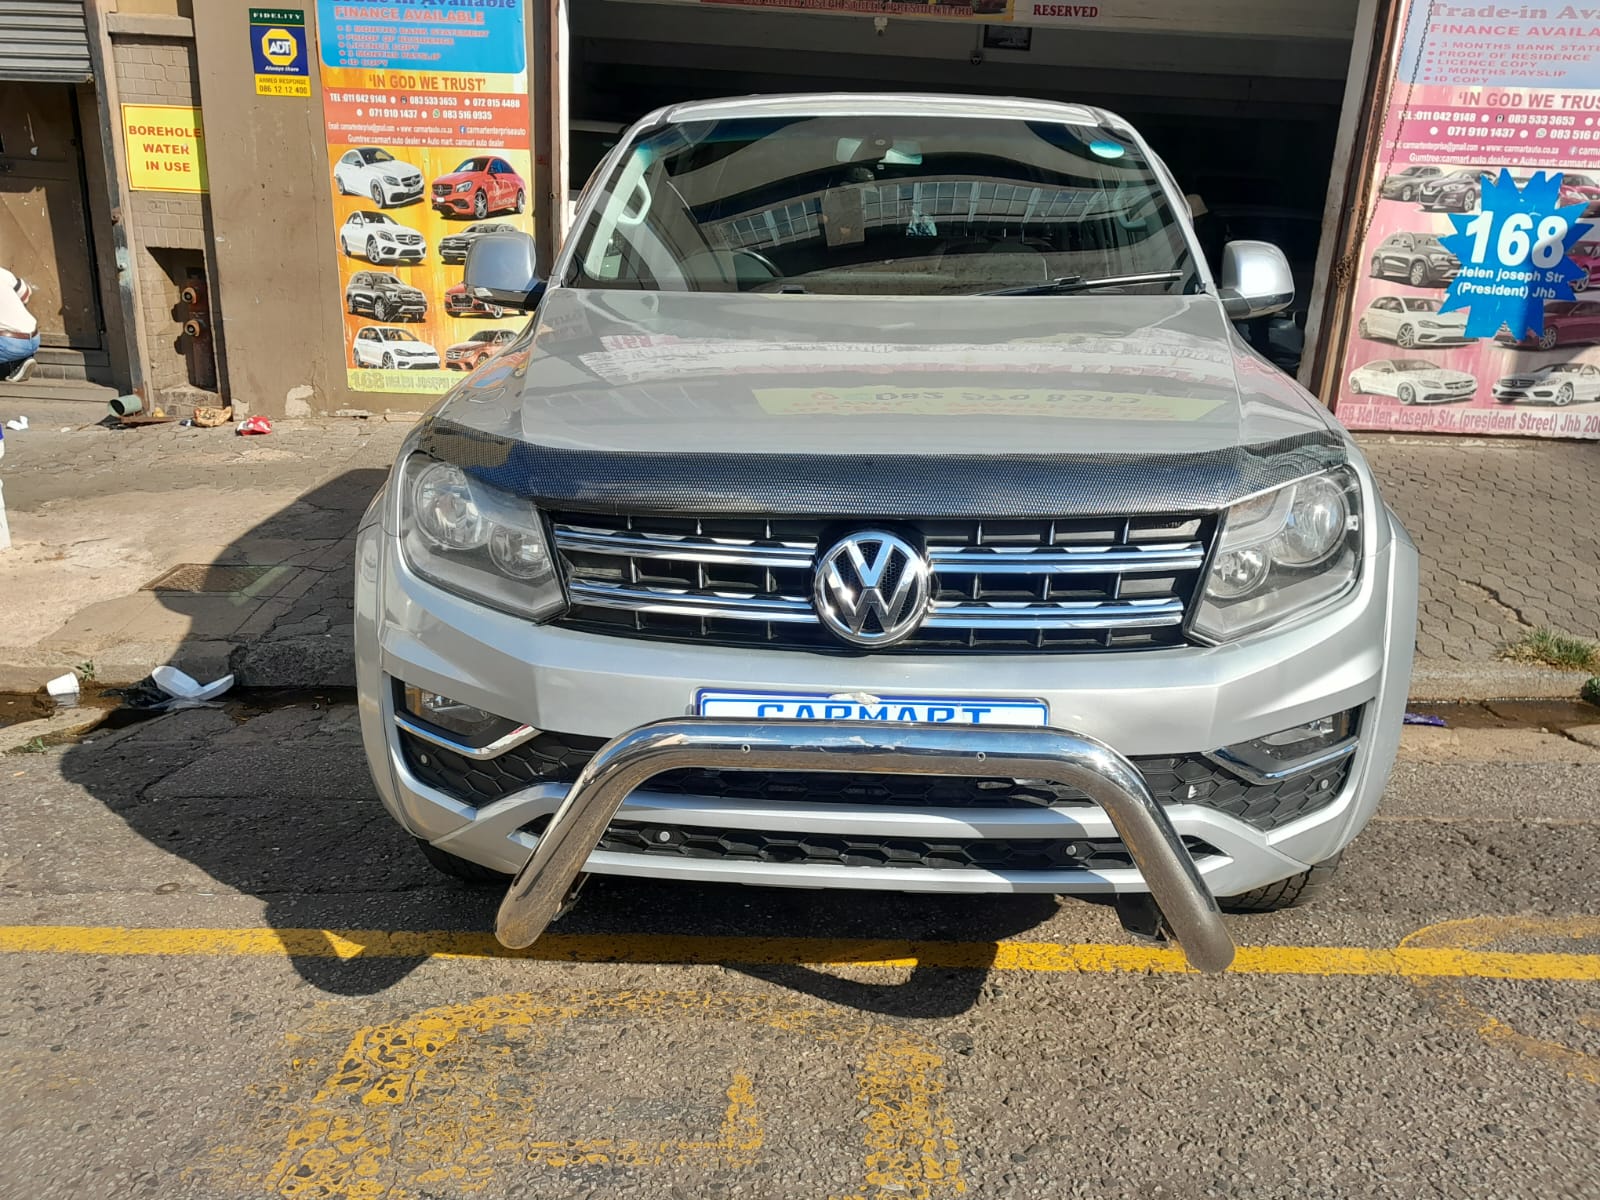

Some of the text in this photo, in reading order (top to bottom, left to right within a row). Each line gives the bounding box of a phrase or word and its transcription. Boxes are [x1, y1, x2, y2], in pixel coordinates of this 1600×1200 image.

[253, 12, 301, 20] FIDELITY
[335, 7, 484, 23] FINANCE AVAILABLE
[1033, 4, 1098, 18] RESERVED
[1430, 3, 1547, 19] Trade-in
[1430, 24, 1520, 36] FINANCE
[269, 40, 291, 54] ADT
[1452, 42, 1511, 50] MONTHS
[1438, 50, 1484, 58] PROOF
[1511, 53, 1592, 62] RESIDENCE
[1437, 59, 1538, 68] LICENCE COPY
[1448, 67, 1507, 75] MONTHS
[1511, 69, 1568, 78] PAYSLIP
[389, 75, 417, 90] GOD
[419, 76, 439, 90] WE
[274, 86, 282, 94] 12
[285, 86, 293, 94] 12
[1486, 92, 1523, 107] GOD
[1528, 93, 1555, 109] WE
[1432, 111, 1452, 122] 042
[1452, 112, 1476, 122] 9148
[1508, 114, 1527, 124] 083
[128, 125, 202, 138] BOREHOLE
[1447, 126, 1467, 137] 071
[1468, 127, 1489, 137] 910
[1550, 129, 1570, 139] 083
[1571, 130, 1591, 140] 516
[143, 143, 190, 155] WATER
[145, 160, 191, 173] IN USE
[1465, 210, 1568, 269] 168
[1457, 266, 1494, 278] Helen
[1544, 271, 1565, 283] Str
[1457, 282, 1556, 299] (President) Jhb
[1394, 407, 1434, 426] Joseph
[1560, 414, 1582, 432] Jhb
